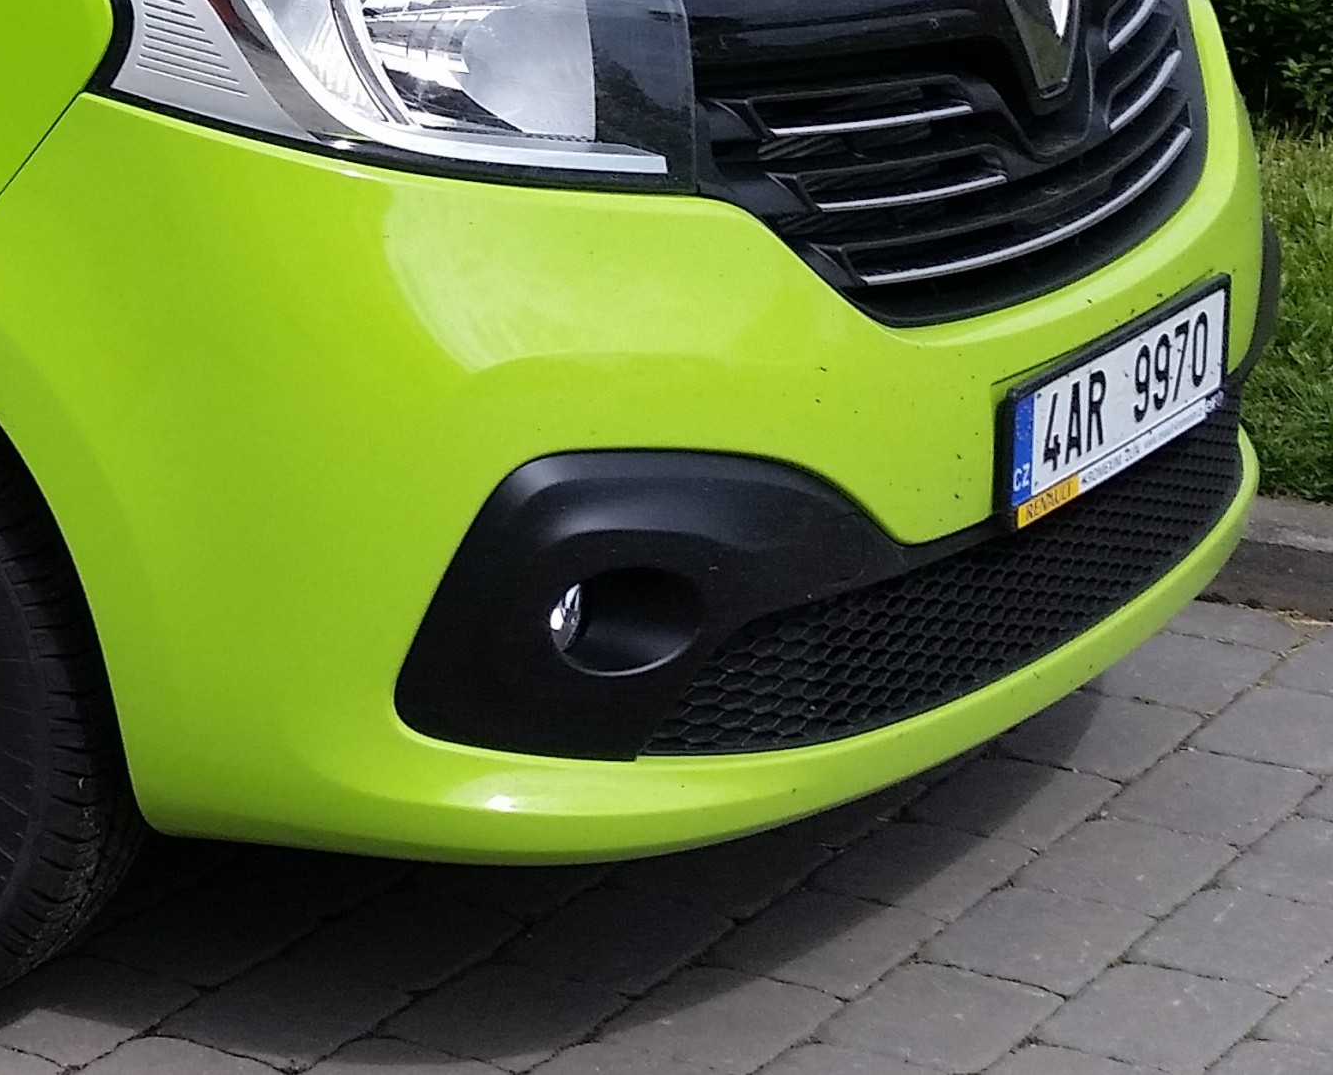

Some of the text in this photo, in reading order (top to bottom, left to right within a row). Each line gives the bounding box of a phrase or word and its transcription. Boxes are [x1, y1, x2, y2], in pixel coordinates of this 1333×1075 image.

[1044, 312, 1208, 471] 4AR 9970
[1013, 463, 1030, 492] CZ
